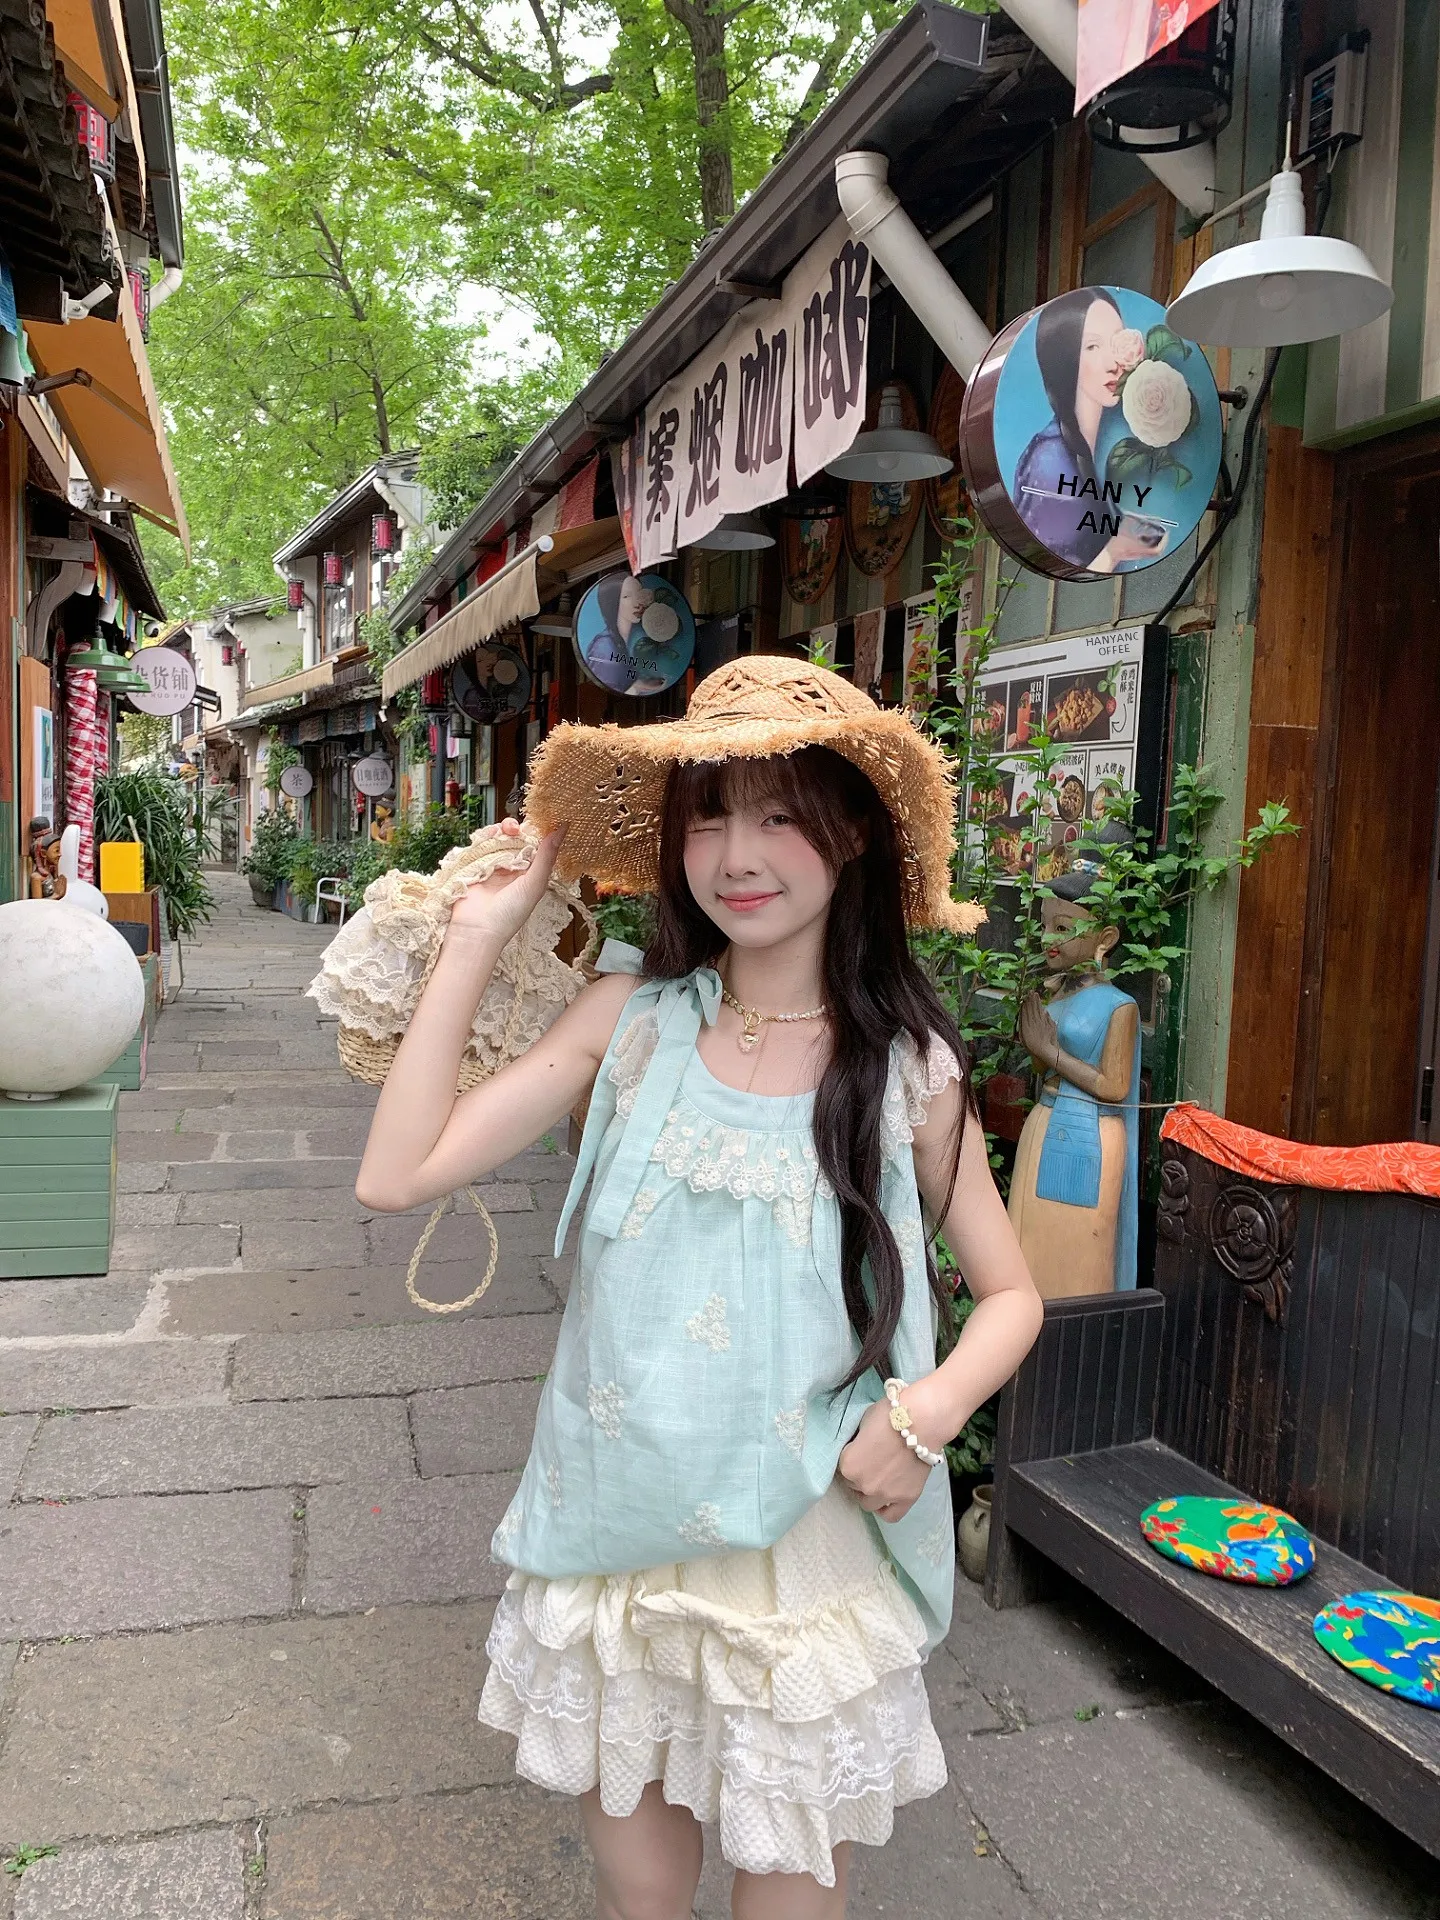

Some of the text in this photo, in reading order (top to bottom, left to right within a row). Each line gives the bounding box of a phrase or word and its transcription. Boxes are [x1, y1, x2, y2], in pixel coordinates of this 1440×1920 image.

[1057, 473, 1152, 507] HAN Y
[1076, 510, 1120, 537] AN
[1086, 631, 1139, 647] HANYANC
[1098, 643, 1130, 656] OFFEE
[610, 651, 658, 671] HAN YA
[626, 669, 636, 679] N
